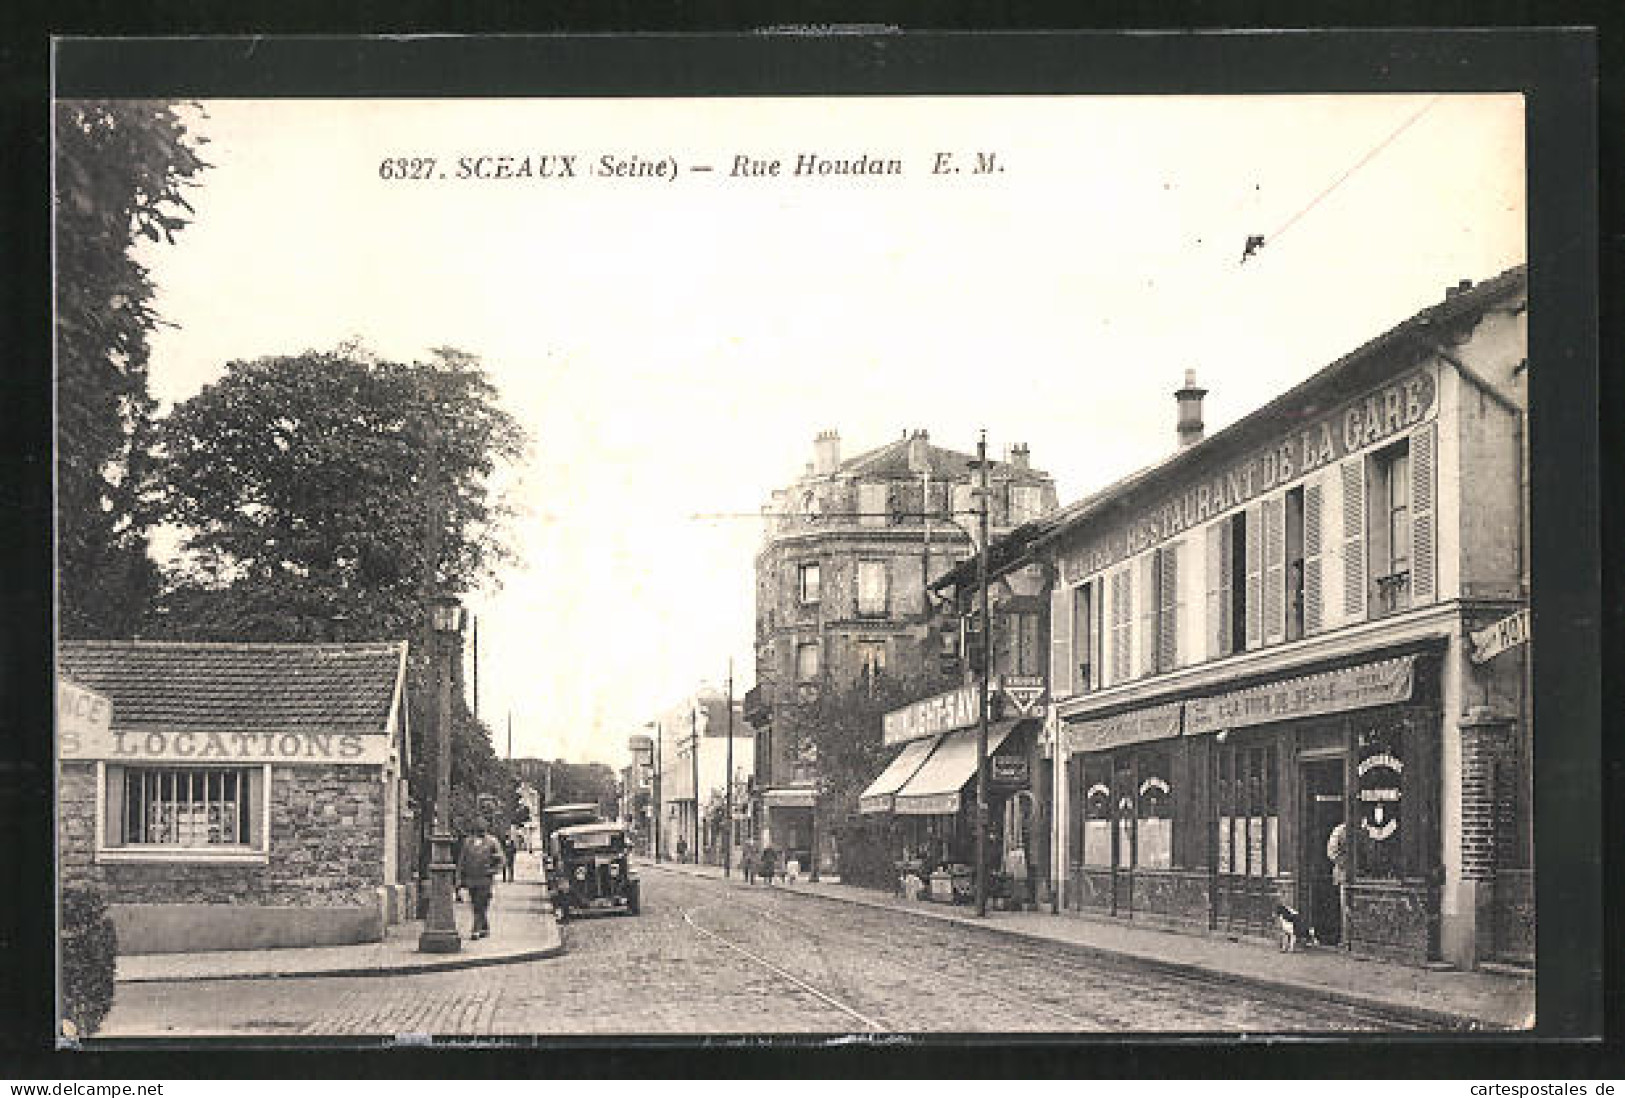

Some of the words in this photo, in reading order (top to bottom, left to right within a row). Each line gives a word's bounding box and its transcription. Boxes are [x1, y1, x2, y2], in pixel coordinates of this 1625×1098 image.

[1127, 457, 1256, 553] RESTAURANT
[1262, 444, 1295, 489] DE
[1301, 421, 1337, 472] LA
[1344, 380, 1425, 451] GARE
[112, 730, 364, 758] LOCATIONS
